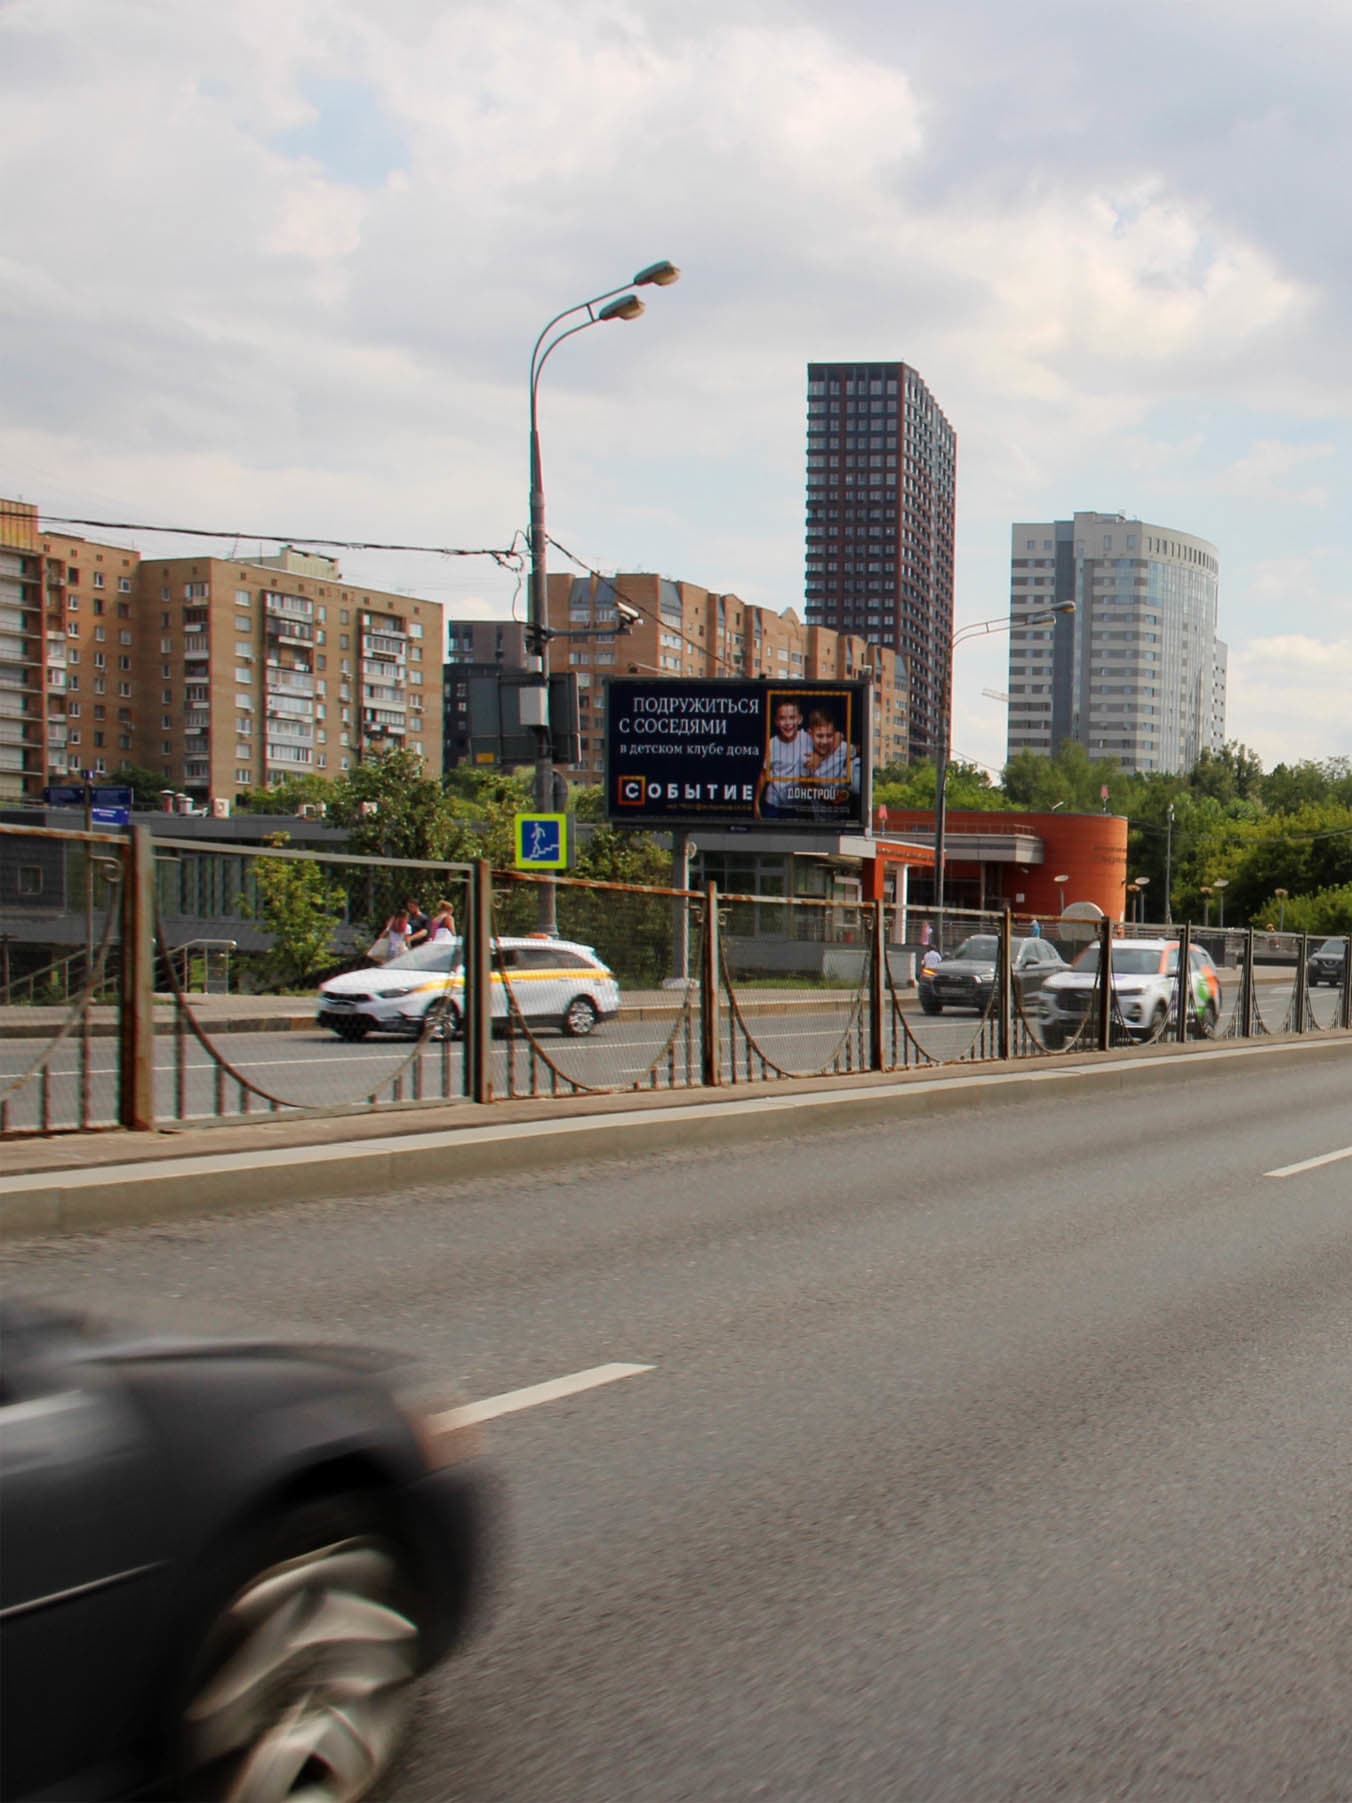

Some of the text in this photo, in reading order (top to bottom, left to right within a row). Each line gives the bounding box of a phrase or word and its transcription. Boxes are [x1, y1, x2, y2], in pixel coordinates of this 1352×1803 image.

[633, 697, 759, 715] ПОДРУЖИТЬСЯ
[619, 718, 727, 735] С СОСЕДЯМИ
[620, 742, 759, 758] в детском клубе дома
[625, 783, 753, 801] СОБЫТИЕ
[787, 785, 837, 801] ДОНСТРОЙ
